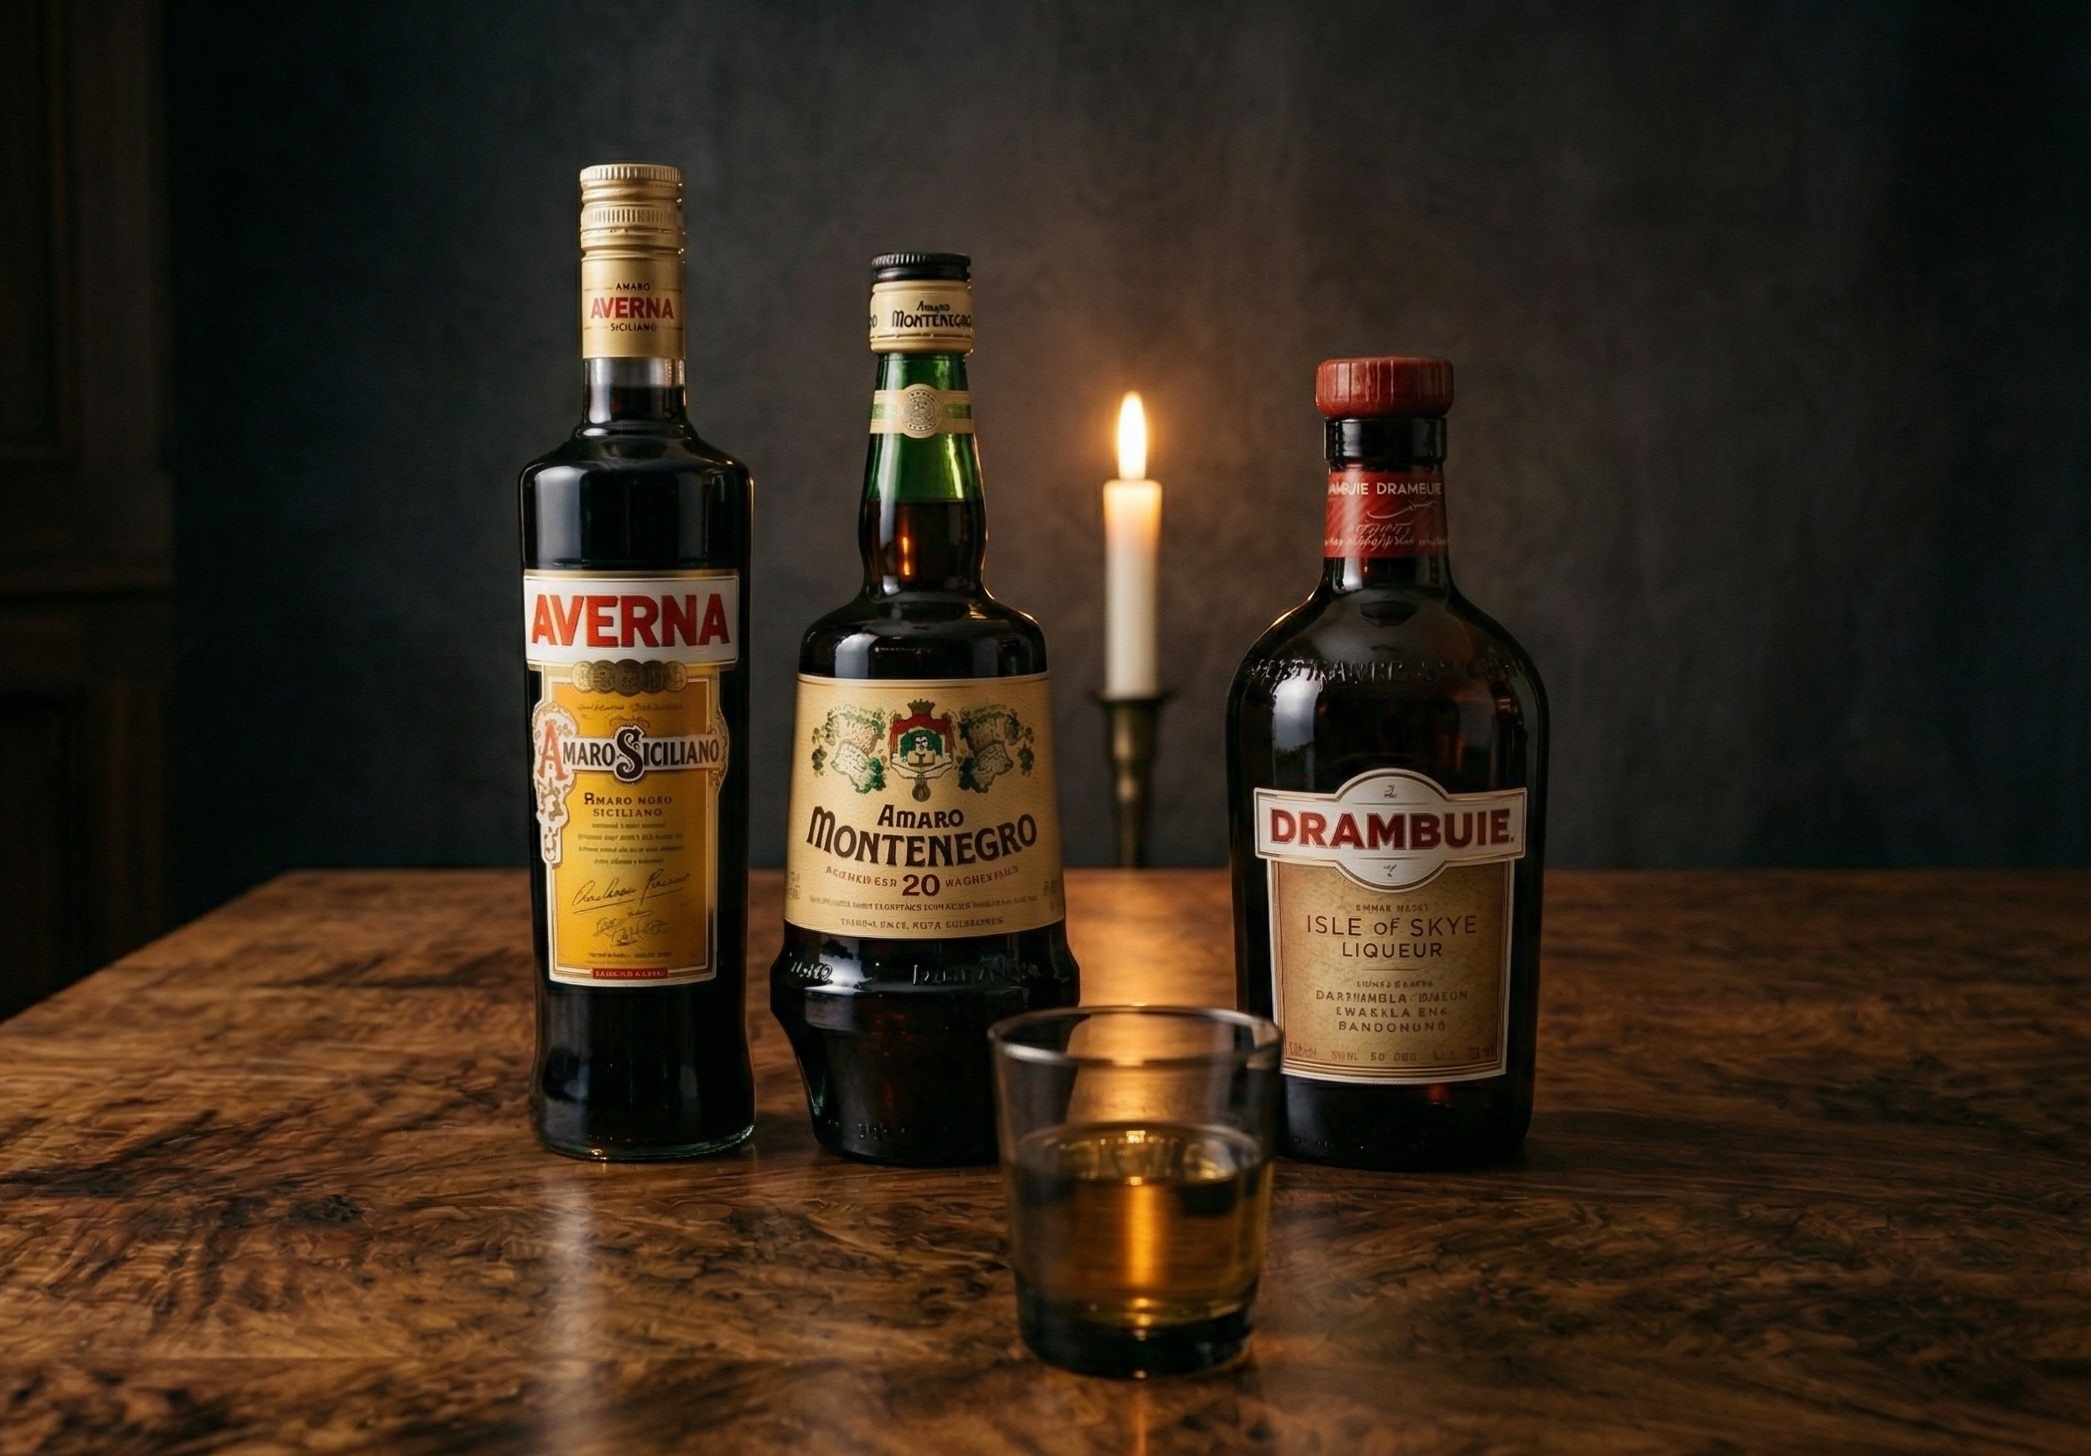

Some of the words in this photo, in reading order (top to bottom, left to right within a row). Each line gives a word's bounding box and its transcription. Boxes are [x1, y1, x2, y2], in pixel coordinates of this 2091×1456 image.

[615, 282, 651, 291] AMARO
[590, 297, 675, 319] AVERNA
[610, 322, 658, 332] SICILIANO
[531, 593, 731, 648] AVERNA
[537, 720, 617, 781] AMARO
[614, 726, 720, 781] SICILIANO
[592, 807, 663, 818] SICILIANO
[877, 804, 965, 829] AMARO
[806, 805, 1038, 868] MONTENEGRO
[902, 873, 941, 897] 20
[1306, 914, 1363, 937] ISLE
[1409, 914, 1478, 938] SKYE
[1342, 942, 1443, 959] LIQUEUR
